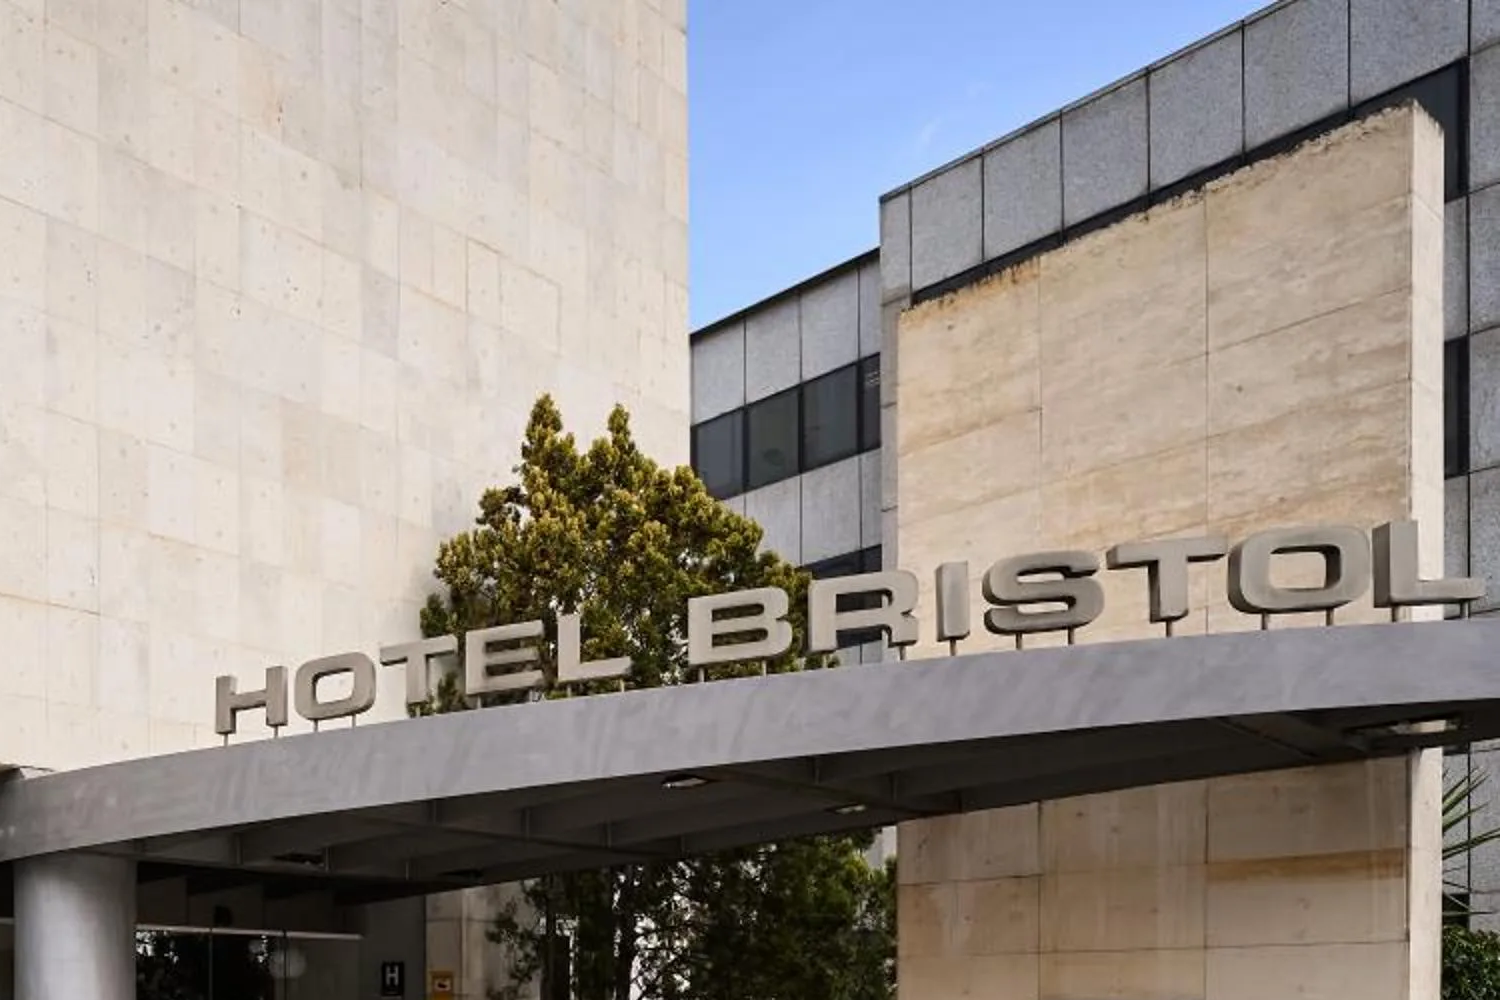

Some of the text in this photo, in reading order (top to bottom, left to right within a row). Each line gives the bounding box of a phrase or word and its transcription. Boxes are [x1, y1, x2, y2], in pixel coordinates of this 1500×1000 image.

[215, 519, 1487, 735] HOTEL BRISTOL
[385, 965, 399, 986] H
